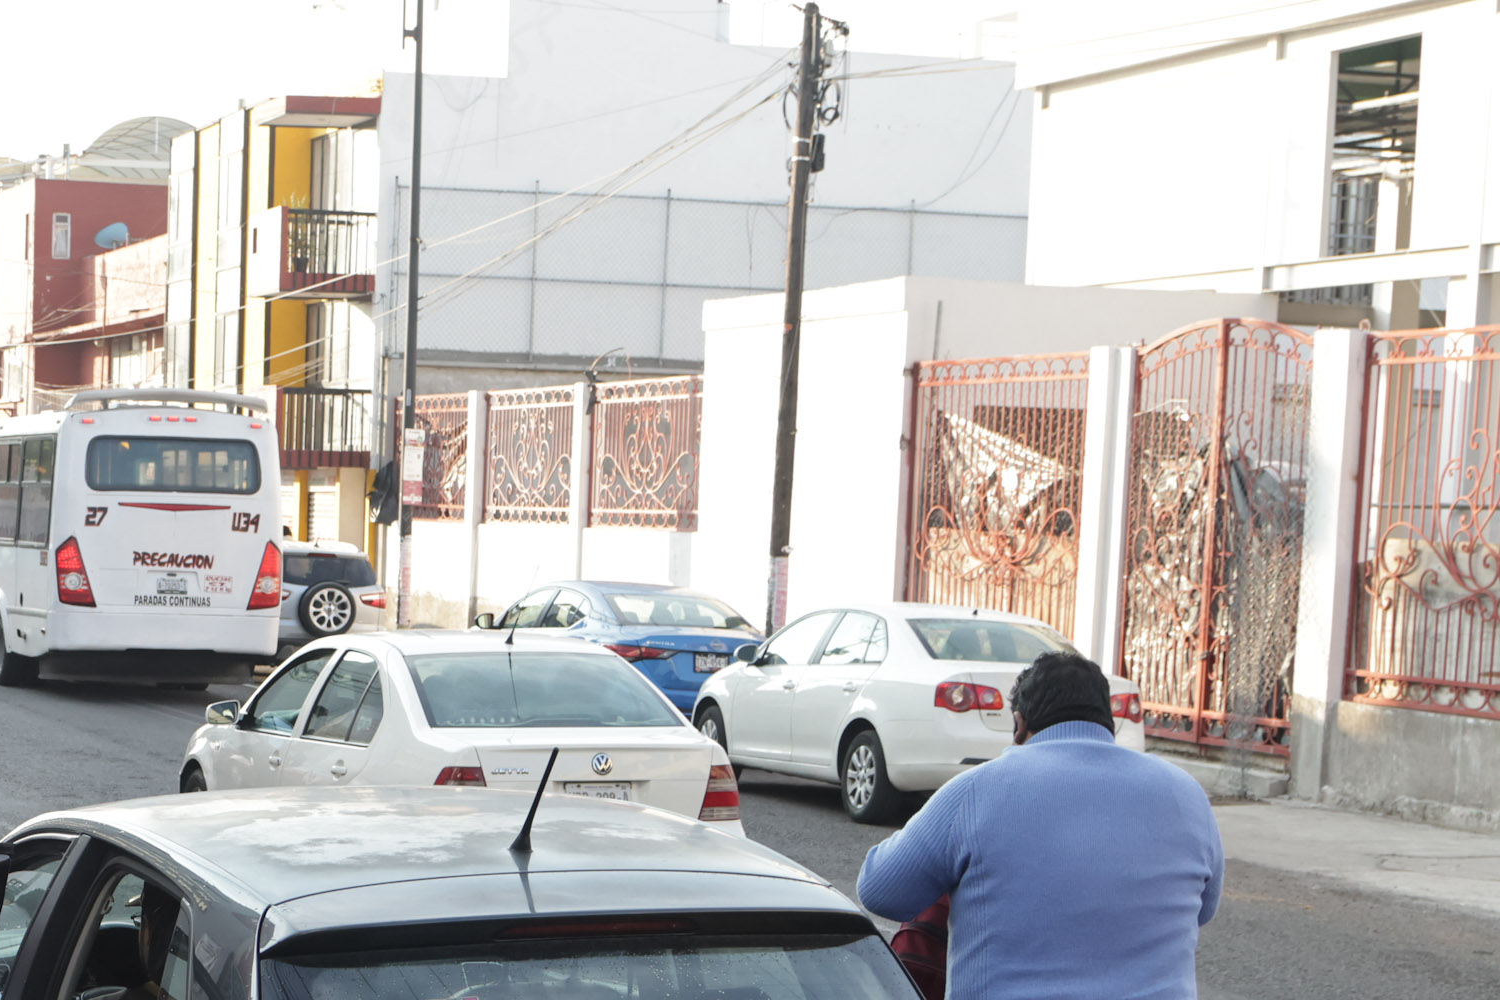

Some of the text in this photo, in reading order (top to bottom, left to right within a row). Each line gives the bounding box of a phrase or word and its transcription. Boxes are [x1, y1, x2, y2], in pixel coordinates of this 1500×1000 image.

[84, 507, 108, 527] 27
[231, 512, 260, 533] U34
[132, 550, 215, 570] PRECAUCION
[134, 595, 211, 608] PARADAS CONTINUAS
